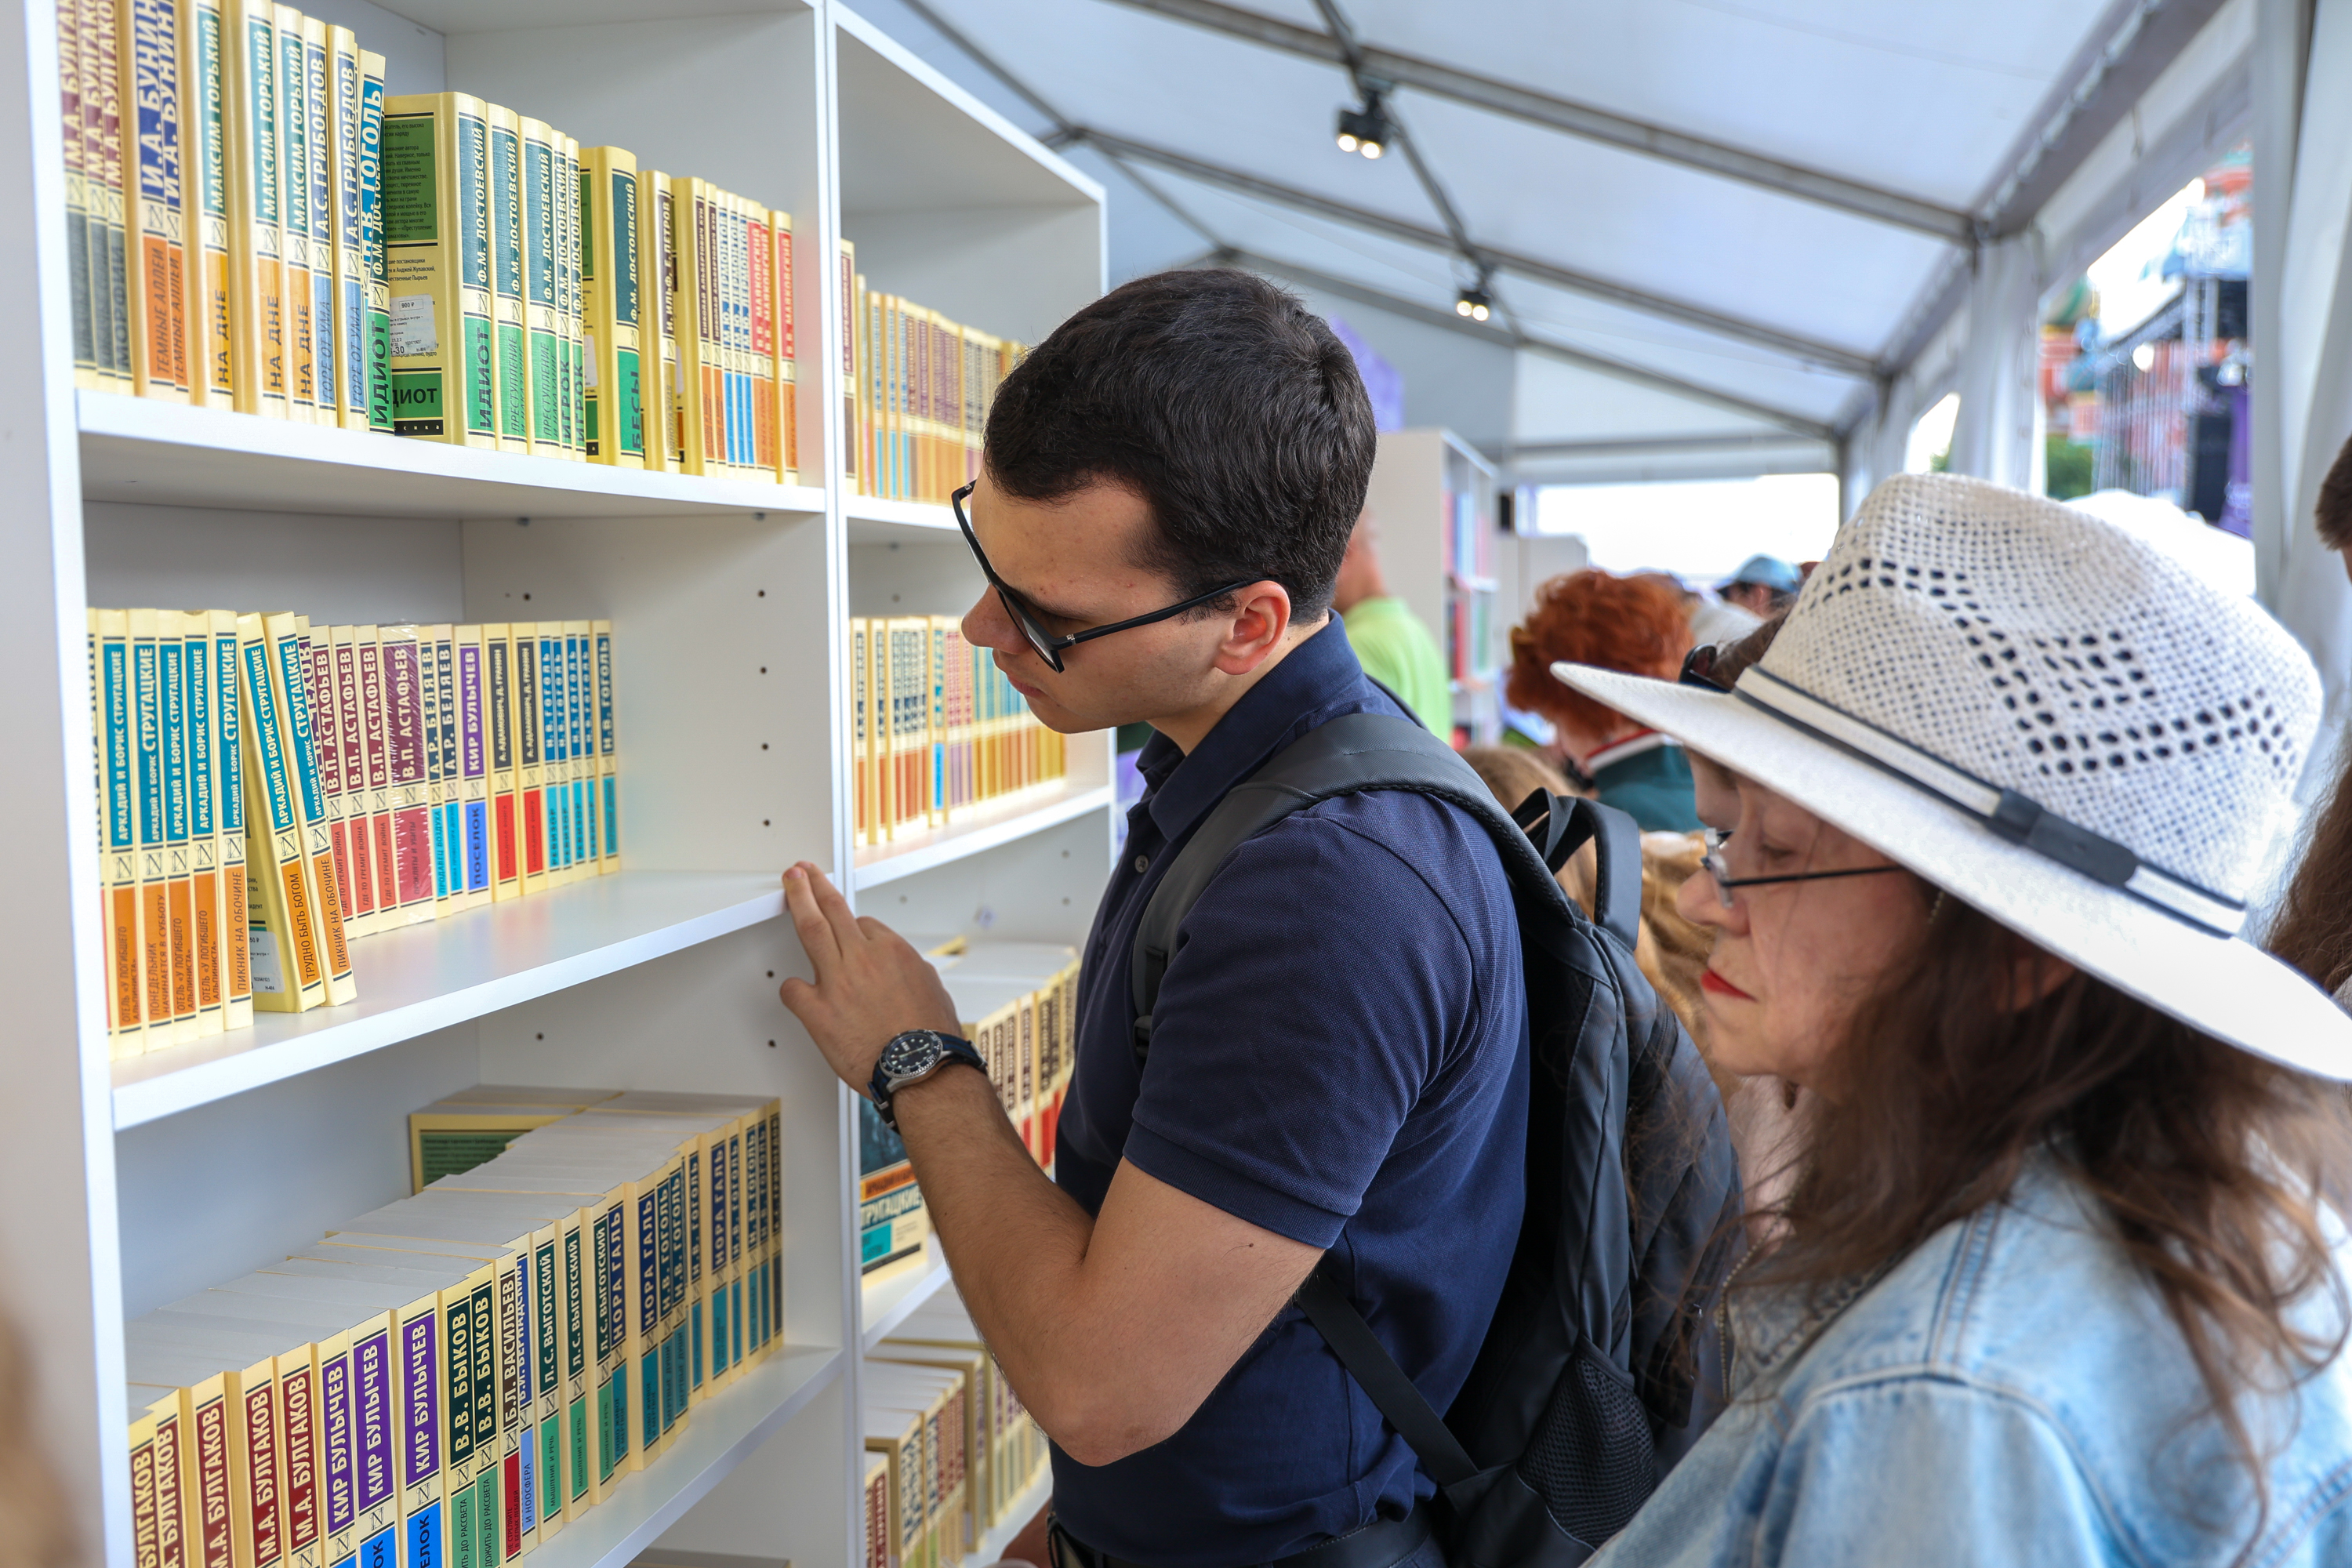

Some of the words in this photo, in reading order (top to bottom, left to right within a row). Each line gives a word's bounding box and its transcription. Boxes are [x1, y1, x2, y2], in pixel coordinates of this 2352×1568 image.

[136, 0, 161, 111] БУНИН
[202, 19, 220, 114] ГОРЬКИЙ
[285, 45, 303, 136] ГОРЬКИЙ
[310, 57, 328, 188] ГРИБОЕДОВ
[342, 66, 358, 195] ГРИБОЕДОВ
[360, 90, 382, 192] ГОГОЛЬ
[140, 123, 164, 189] И.А.
[209, 122, 224, 209] МАКСИМ
[291, 143, 306, 227] МАКСИМ
[315, 194, 329, 234] А.С.
[345, 201, 359, 240] А.С.
[542, 153, 553, 261] ДОСТОЕВСКИЙ
[543, 265, 553, 299] Ф.М.
[215, 289, 229, 340] ДНЕ
[298, 304, 310, 353] ДНЕ
[218, 351, 229, 383] НА
[299, 363, 311, 394] НА
[372, 321, 390, 424] ИДИОТ
[477, 327, 492, 428] ИДИОТ
[540, 342, 552, 436] ПРЕСТУПЛЕНИЕ
[561, 359, 571, 439] ИГРОК
[574, 363, 585, 442] ИГРОК
[630, 371, 641, 448] БЕСЫ
[221, 642, 237, 742] СТРУГАЦКИЕ
[284, 643, 309, 738] СТРУГАЦКИЕ
[316, 653, 336, 747] АСТАФЬЕВ
[363, 650, 382, 741] АСТАФЬЕВ
[394, 648, 413, 738] АСТАФЬЕВ
[422, 652, 437, 728] БЕЛЯЕВ
[438, 649, 454, 725] БЕЛЯЕВ
[465, 652, 478, 733] БУЛЫЧЕВ
[555, 654, 564, 717] ГОГОЛЬ
[569, 651, 579, 713] ГОГОЛЬ
[582, 652, 591, 713] ГОГОЛЬ
[303, 739, 314, 766] БОРИС
[325, 752, 339, 789] В.П.
[371, 746, 386, 782] В.П.
[401, 742, 416, 778] В.П.
[428, 736, 440, 774] А.Р.
[444, 732, 456, 770] А.Р.
[468, 736, 480, 771] КИР
[230, 784, 241, 826] АРКАДИЙ
[310, 775, 323, 816] АРКАДИЙ
[359, 853, 368, 880] ГРЕМИТ
[472, 807, 482, 885] ПОСЕЛОК
[232, 872, 243, 923] ОБОЧИНЕ
[289, 873, 303, 908] БОГОМ
[321, 859, 336, 906] ОБОЧИНЕ
[158, 895, 167, 938] СУББОТУ
[173, 917, 183, 969] ПОГИБШЕГО
[198, 909, 209, 961] ПОГИБШЕГО
[235, 927, 244, 942] НА
[295, 911, 308, 938] БЫТЬ
[330, 909, 339, 924] НА
[201, 963, 209, 973] «У
[209, 941, 220, 1000] АЛЬПИНИСТА»
[235, 946, 247, 991] ПИКНИК
[301, 940, 315, 979] ТРУДНО
[331, 927, 347, 967] ПИКНИК
[147, 942, 160, 1015] ПОНЕДЕЛЬНИК
[159, 951, 170, 1013] НАЧИНАЕТСЯ
[176, 983, 186, 1011] ОТЕЛЬ
[185, 949, 194, 1009] АЛЬПИНИСТА»
[201, 975, 211, 1002] ОТЕЛЬ
[690, 1162, 699, 1230] ГОГОЛЬ
[714, 1149, 724, 1204] ГАЛЬ
[611, 1212, 622, 1272] ГАЛЬ
[659, 1189, 670, 1264] ГОГОЛЬ
[672, 1177, 682, 1252] ГОГОЛЬ
[714, 1208, 725, 1266] НОРА
[503, 1279, 516, 1380] ВАСИЛЬЕВ
[539, 1253, 554, 1348] ВЫГОТСКИЙ
[612, 1277, 623, 1341] НОРА
[452, 1312, 468, 1398] БЫКОВ
[475, 1297, 491, 1381] БЫКОВ
[363, 1345, 382, 1450] БУЛЫЧЕВ
[412, 1323, 429, 1427] БУЛЫЧЕВ
[504, 1381, 517, 1422] Б.Л.
[289, 1376, 311, 1489] БУЛГАКОВ
[455, 1402, 470, 1452] В.В.
[477, 1384, 492, 1433] В.В.
[251, 1392, 274, 1506] БУЛГАКОВ
[368, 1454, 383, 1498] КИР
[416, 1430, 430, 1473] КИР
[133, 1451, 156, 1568] БУЛГАКОВ
[258, 1506, 277, 1559] М.А.
[295, 1488, 314, 1541] М.А.
[485, 1519, 492, 1532] ДО
[485, 1534, 493, 1568] ДОЖИТЬ
